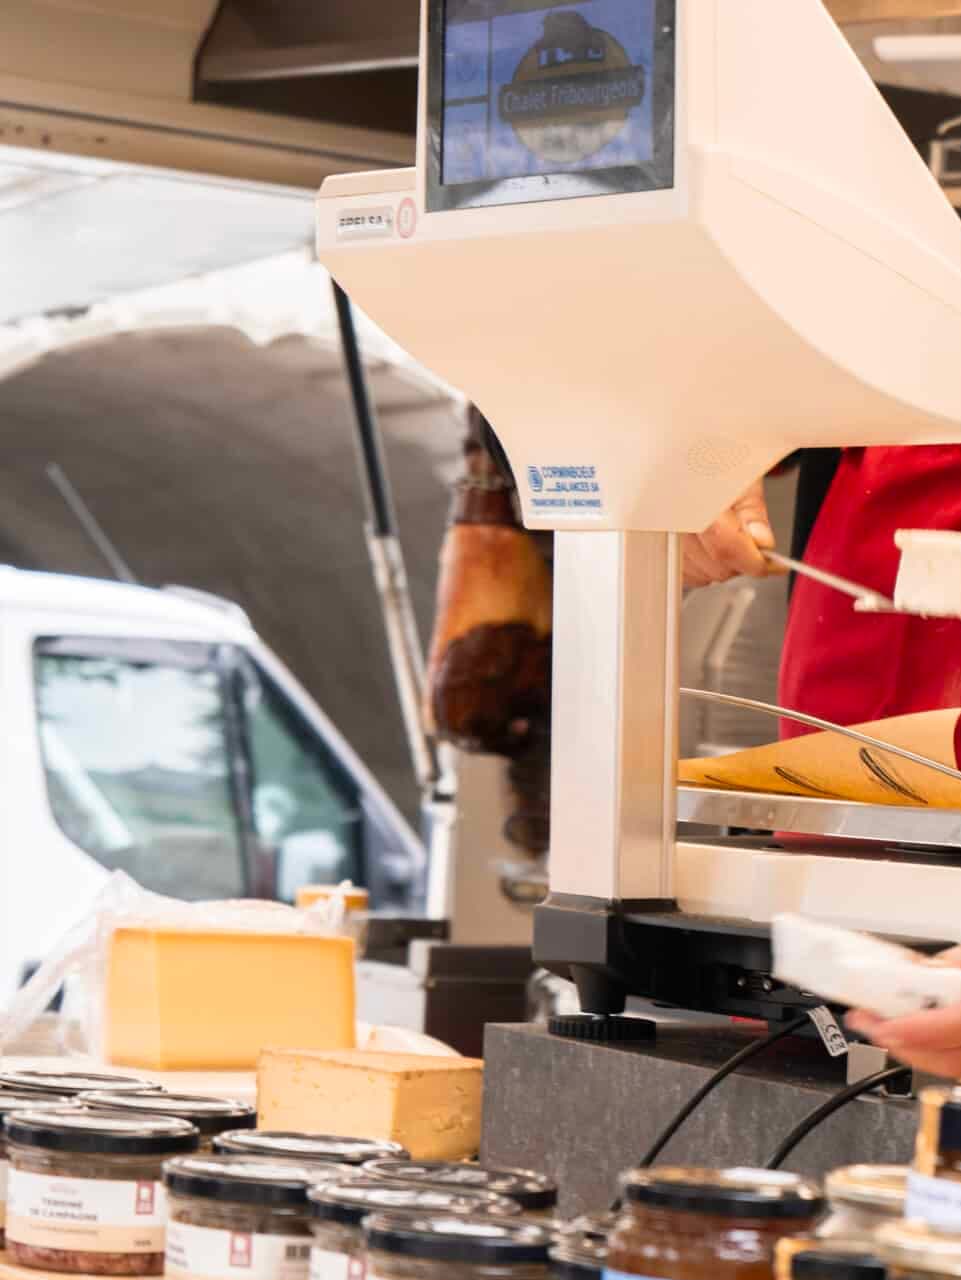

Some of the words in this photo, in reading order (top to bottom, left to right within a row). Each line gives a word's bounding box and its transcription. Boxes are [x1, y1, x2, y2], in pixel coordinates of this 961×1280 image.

[503, 90, 547, 113] Chalet
[550, 80, 640, 106] Fribourgeois
[42, 1209, 98, 1221] CAMPAGNE
